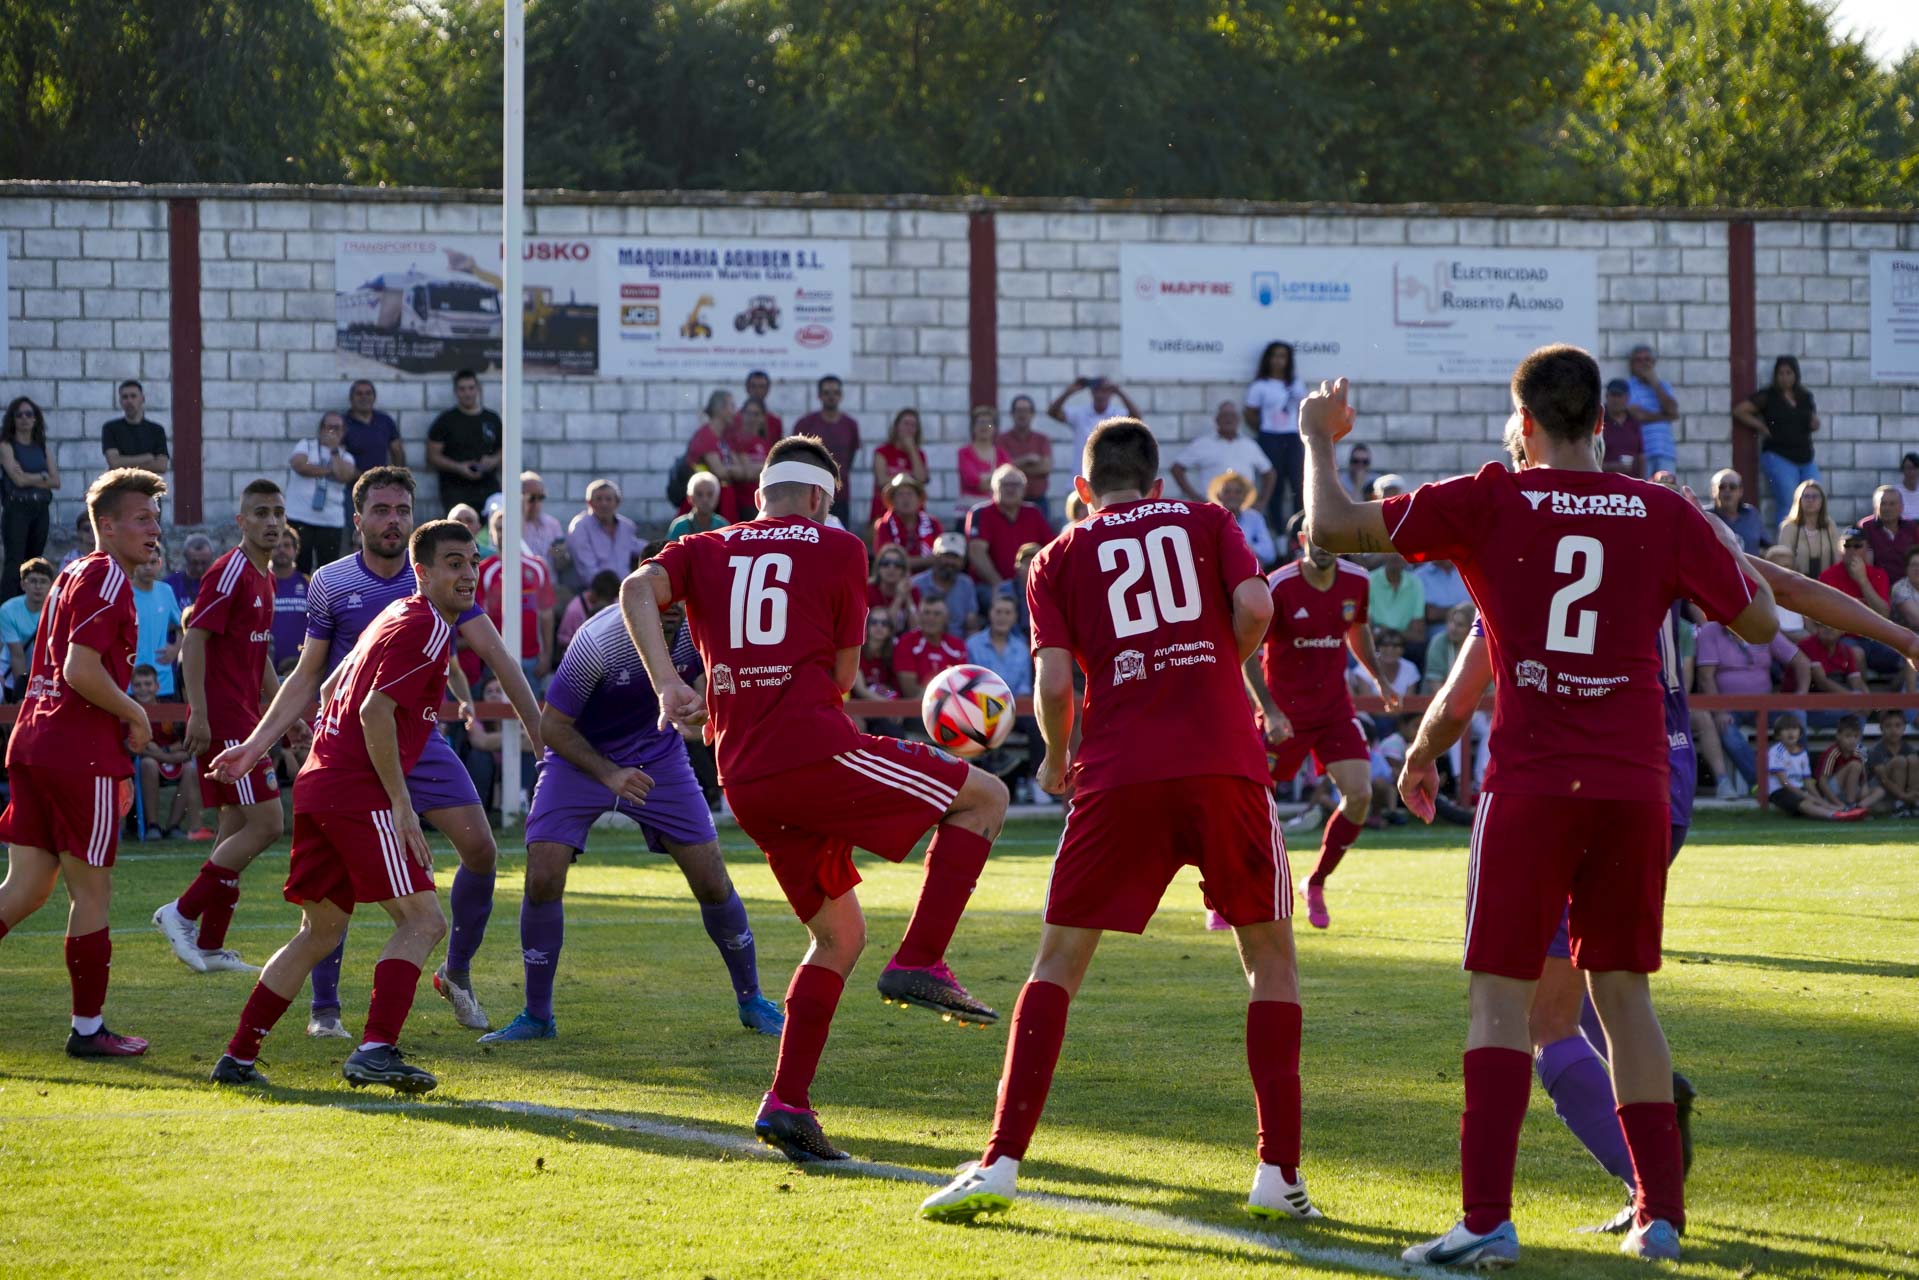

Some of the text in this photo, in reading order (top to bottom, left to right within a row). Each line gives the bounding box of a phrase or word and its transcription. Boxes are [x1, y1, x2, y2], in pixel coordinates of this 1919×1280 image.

[618, 248, 718, 270] MAQUINARIA
[1452, 262, 1548, 281] ELECTRICIDAD
[1160, 281, 1233, 296] MAPFRE
[1442, 290, 1564, 311] ROBERTO ALONSO
[1552, 490, 1646, 509] HYDRA
[1102, 502, 1188, 522] HYDRA
[1551, 504, 1648, 518] CANTALEJO
[740, 533, 820, 544] CANTALEJO
[741, 525, 820, 538] HYDRA
[1097, 525, 1203, 638] 20
[728, 553, 793, 649] 16
[1545, 535, 1604, 655] 2
[1154, 640, 1215, 657] AYUNTAMIENTO
[1154, 655, 1217, 671] DE TURÉGANO
[740, 680, 751, 688] DE
[1557, 672, 1629, 685] AYUNTAMIENTO
[1556, 685, 1571, 695] DE
